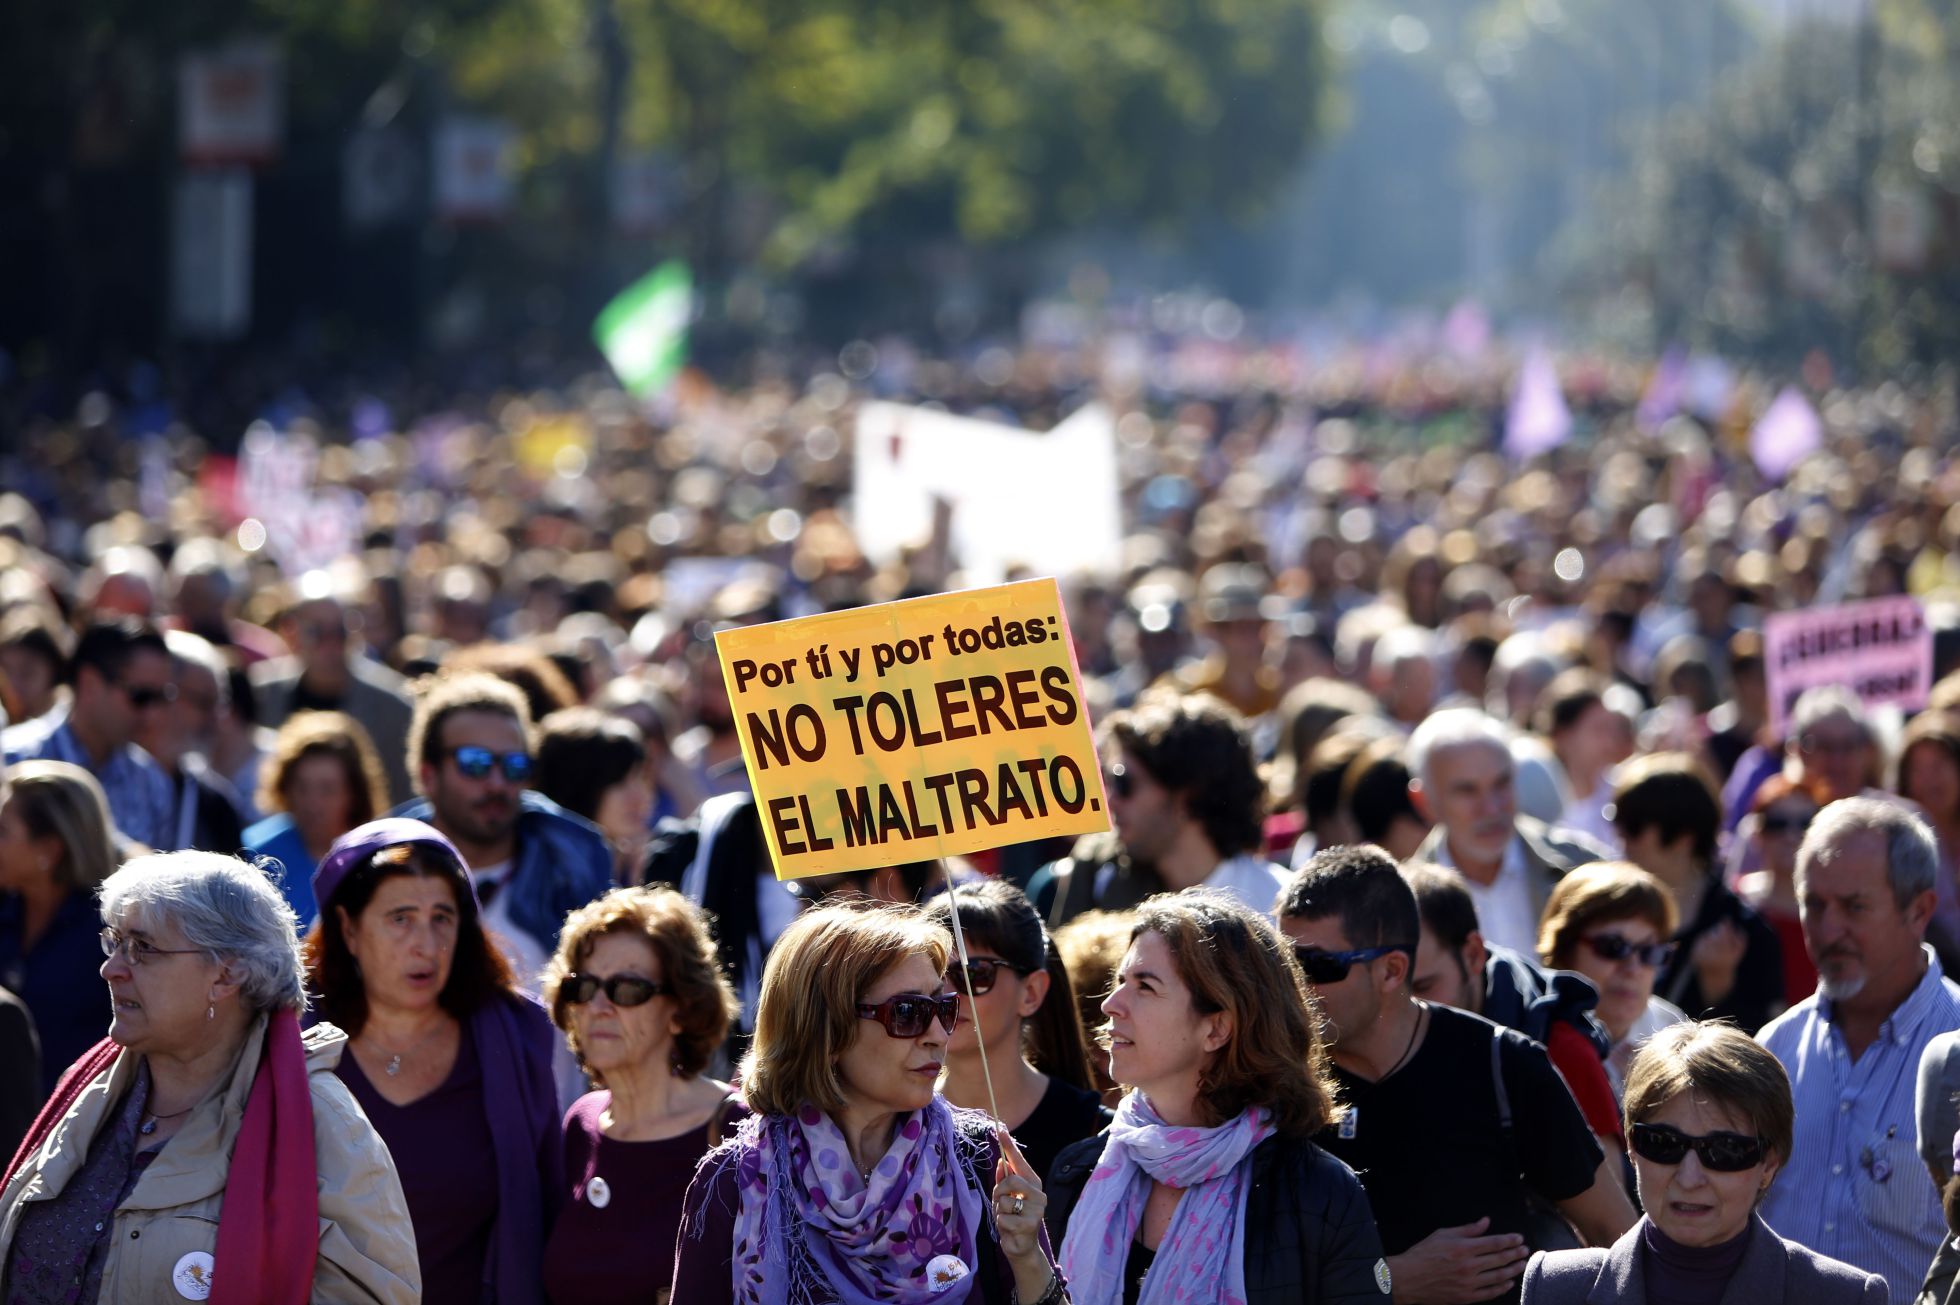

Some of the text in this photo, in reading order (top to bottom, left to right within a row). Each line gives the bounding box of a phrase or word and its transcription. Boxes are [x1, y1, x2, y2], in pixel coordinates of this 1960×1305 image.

[732, 615, 1061, 694] Por tí y por todas:
[746, 665, 1078, 770] NO TOLERES
[767, 754, 1101, 857] EL MALTRATO.
